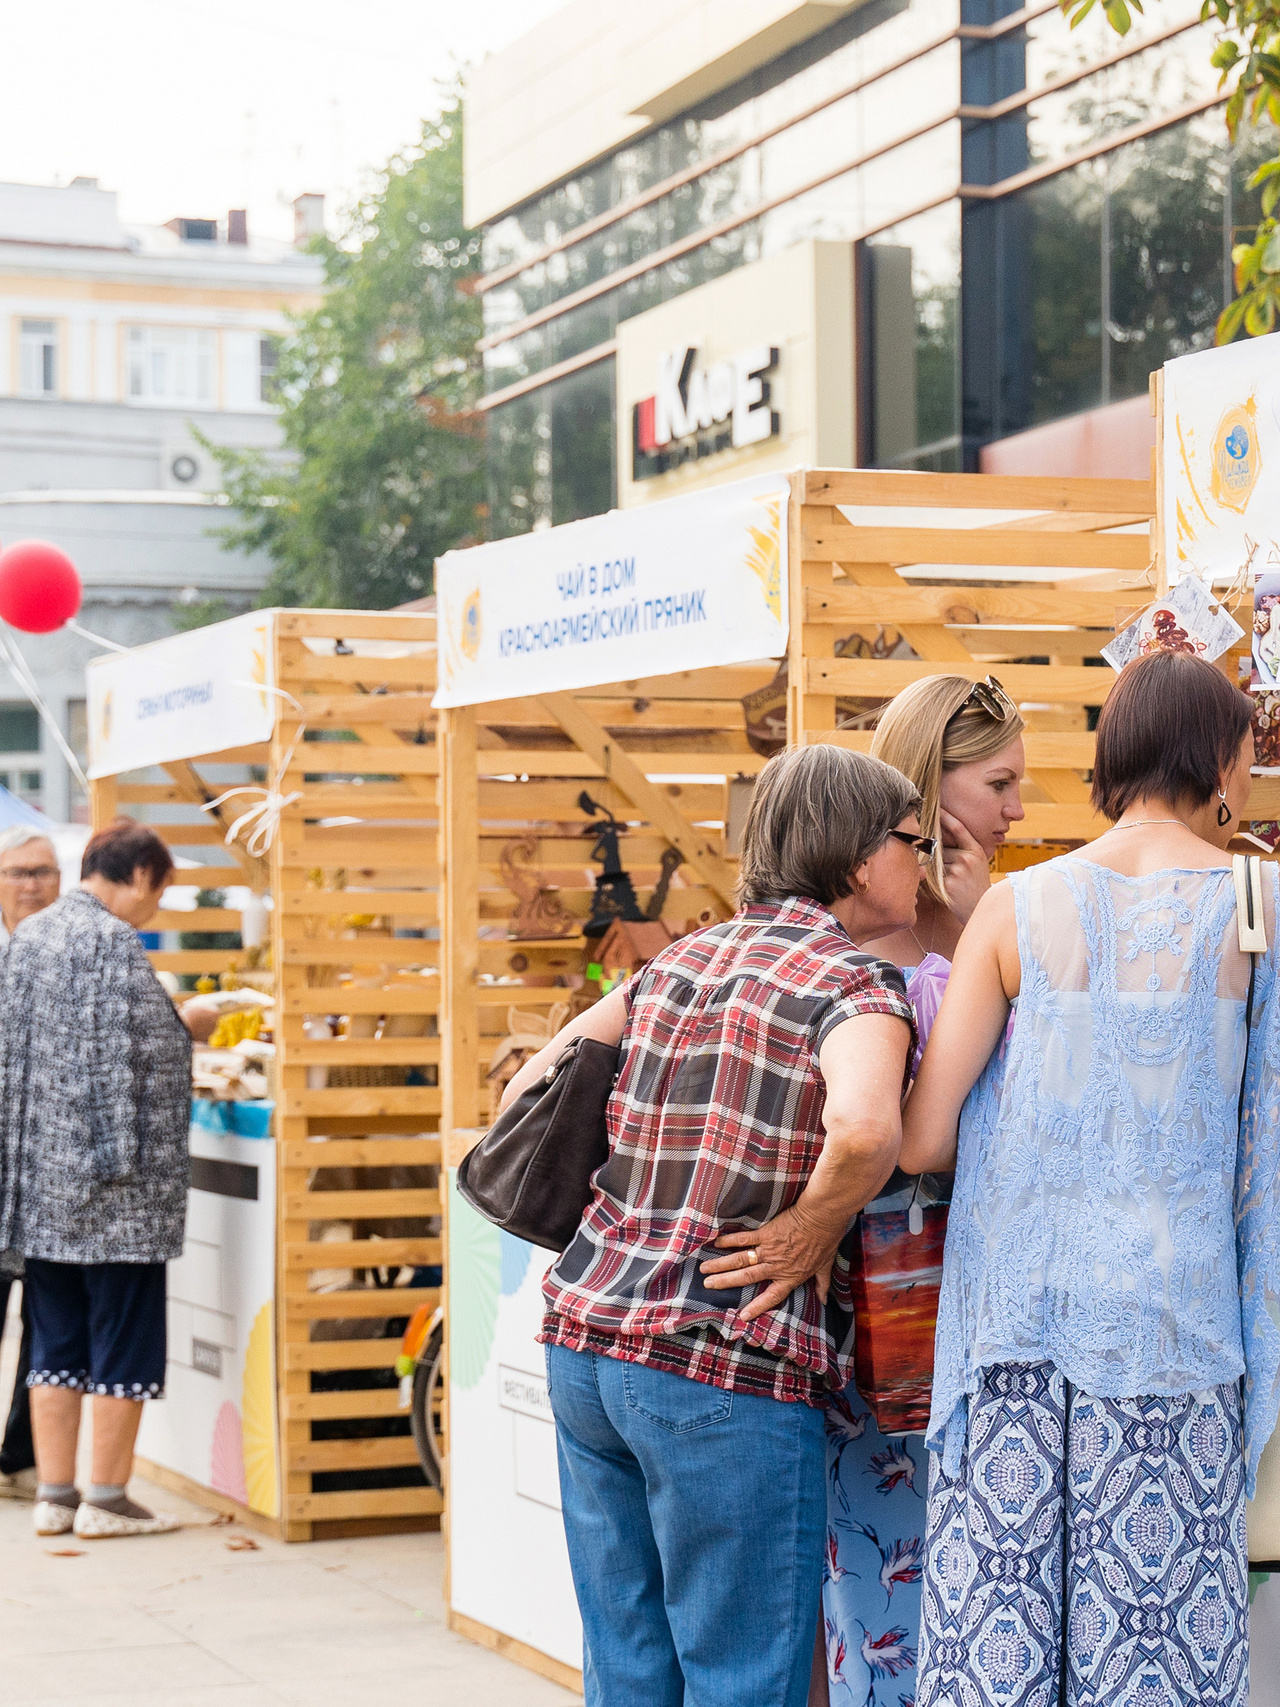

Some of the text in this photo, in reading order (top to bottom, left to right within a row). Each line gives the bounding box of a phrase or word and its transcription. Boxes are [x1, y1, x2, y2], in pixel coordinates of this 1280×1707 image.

[556, 556, 637, 601] ЧАЙ В ДОМ
[499, 589, 707, 658] КРАСНОАРМЕЙСКИЙ ПРЯНИК
